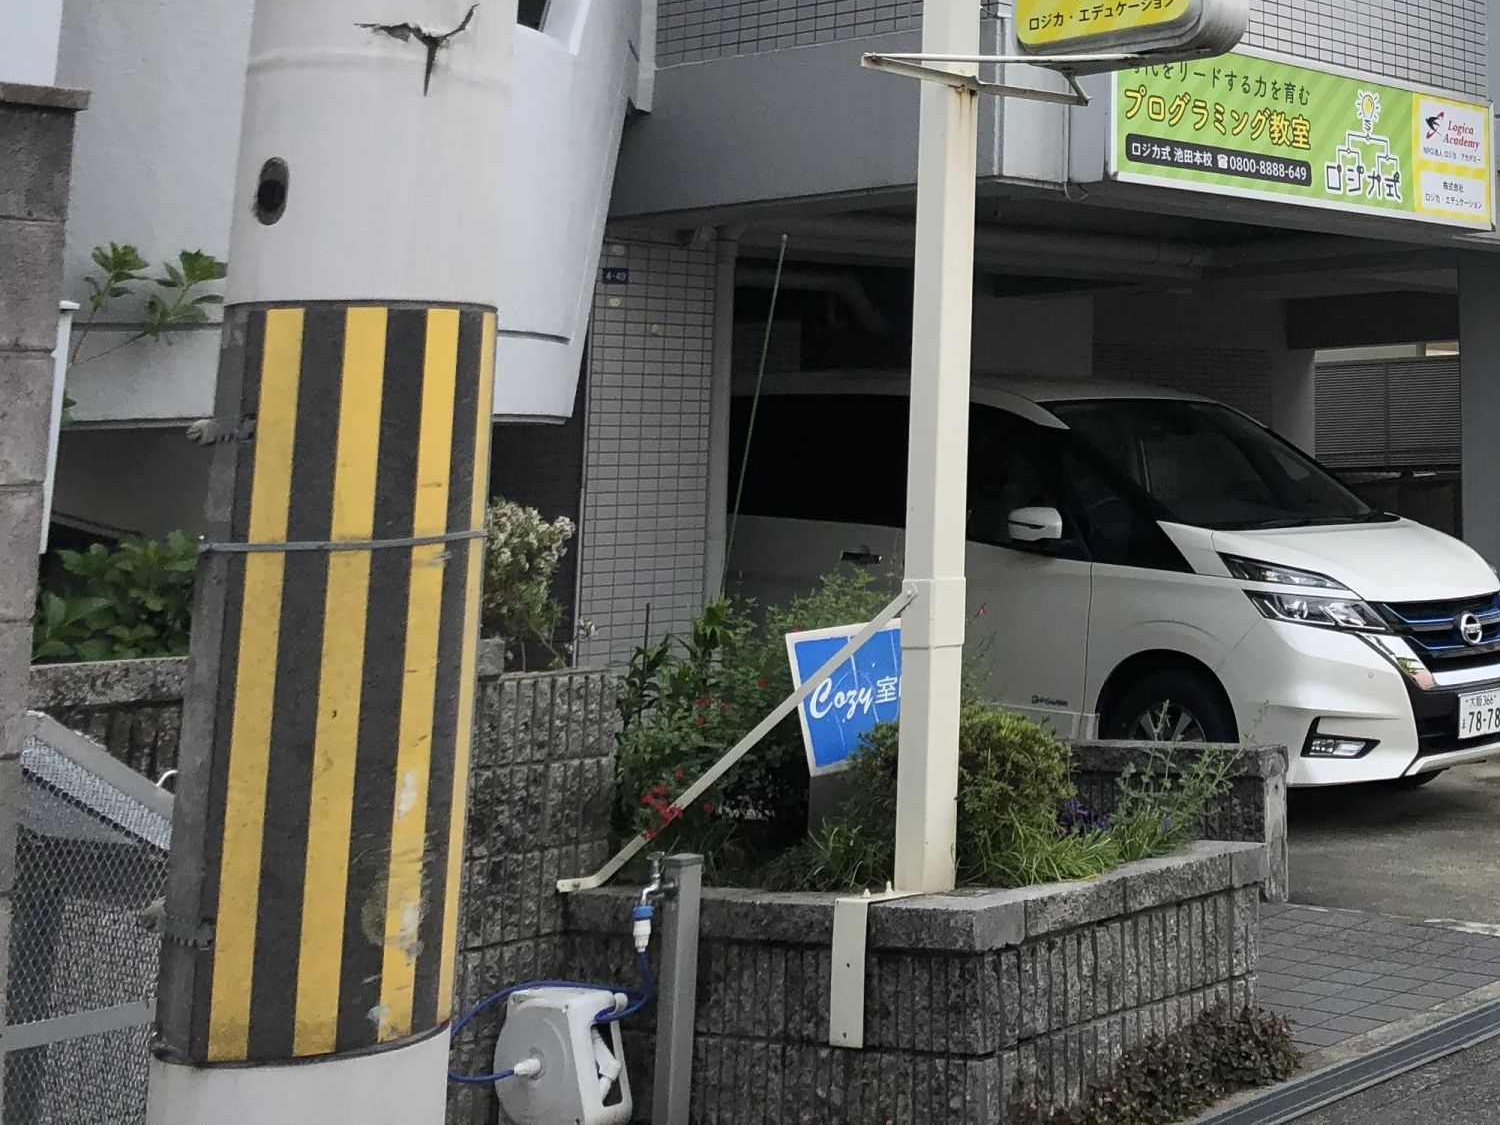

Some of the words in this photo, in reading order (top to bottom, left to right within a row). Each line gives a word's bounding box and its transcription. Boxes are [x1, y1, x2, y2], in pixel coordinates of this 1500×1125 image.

[1135, 62, 1311, 106] をリードする力を育む
[1124, 84, 1312, 150] プログラミング教室
[1447, 121, 1474, 136] Logica
[1131, 142, 1172, 162] ロジカ式
[1173, 147, 1213, 167] 池田本校
[1443, 134, 1480, 152] Academy
[1468, 707, 1500, 734] 78-78
